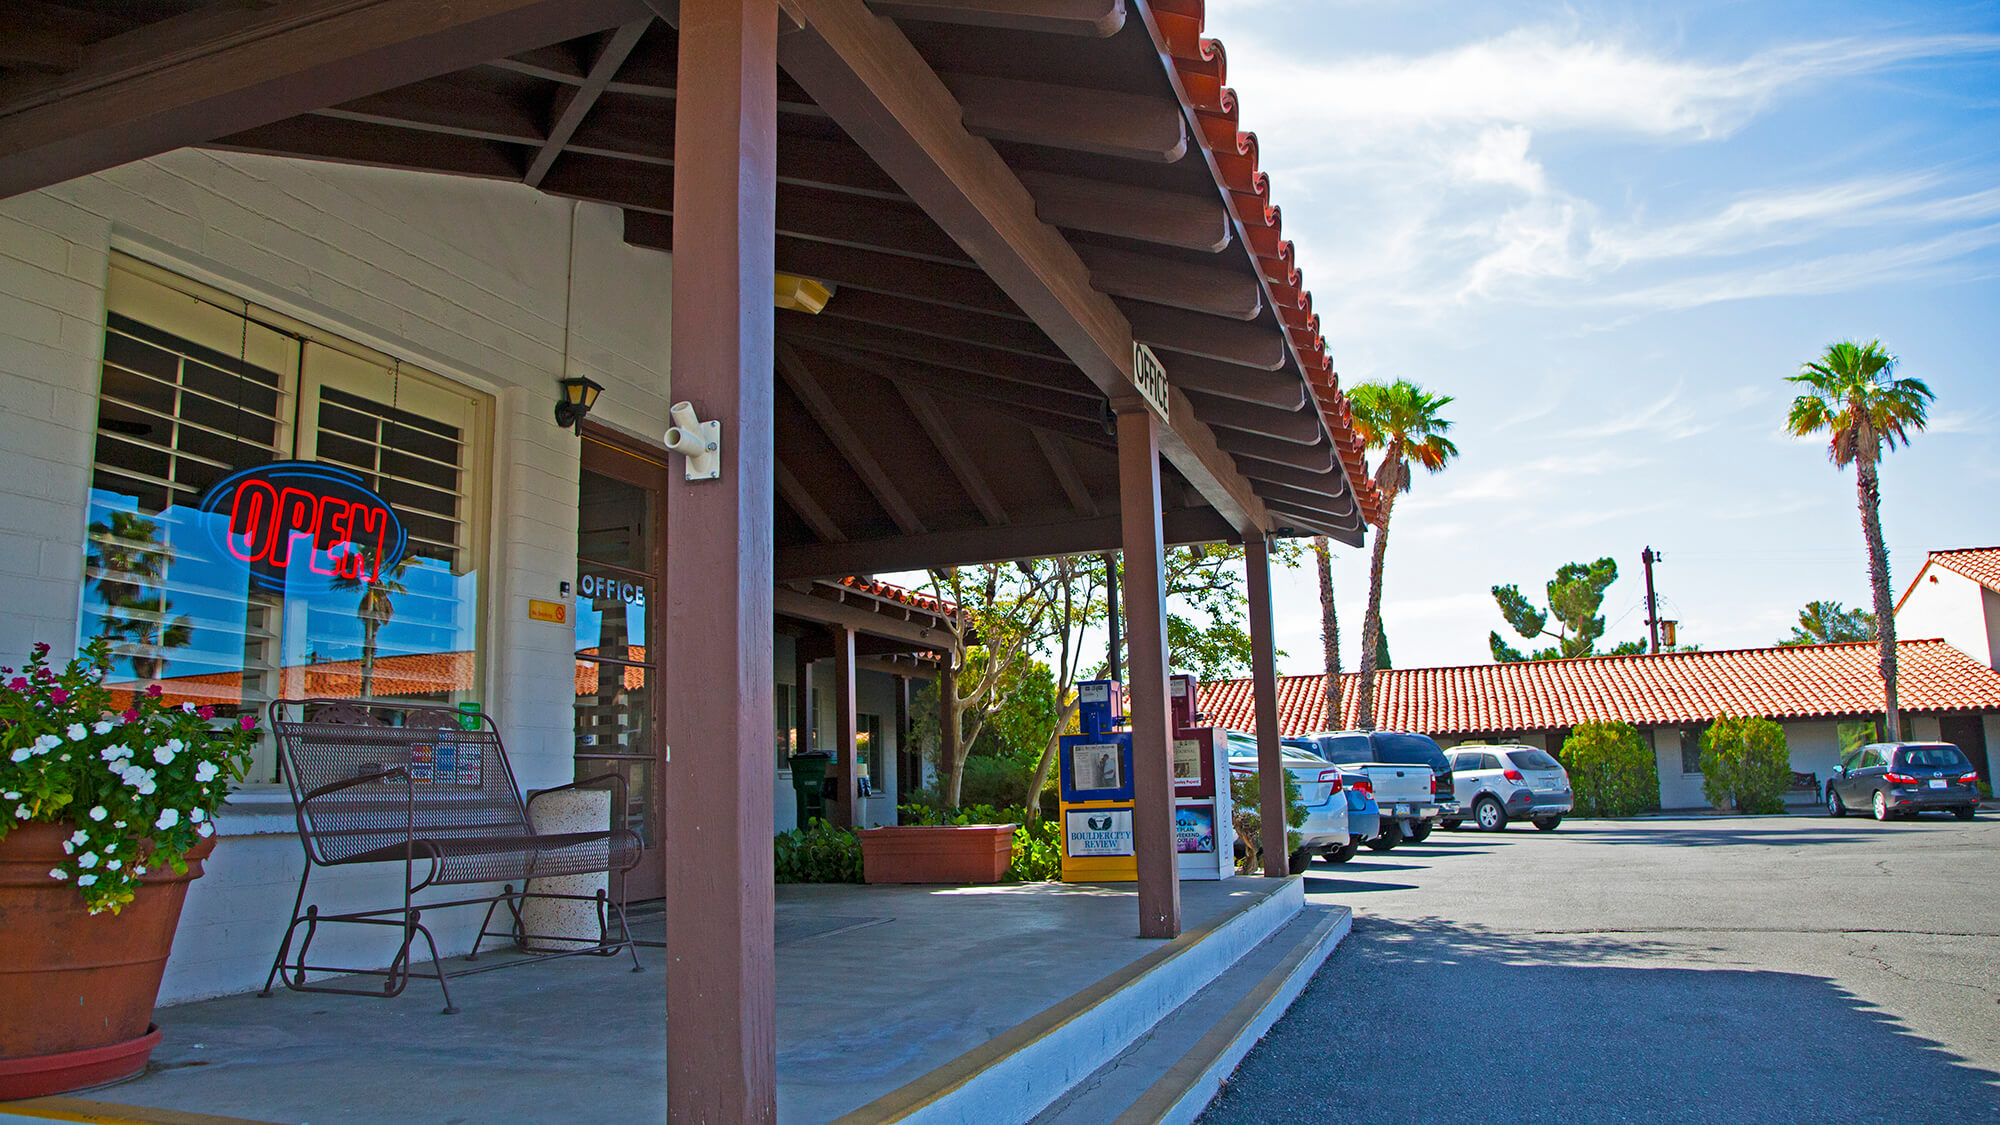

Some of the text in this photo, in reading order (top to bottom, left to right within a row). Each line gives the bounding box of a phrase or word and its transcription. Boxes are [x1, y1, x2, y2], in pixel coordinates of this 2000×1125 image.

[1136, 343, 1168, 415] OFFICE
[227, 479, 387, 583] OPEN
[582, 575, 645, 607] OFFICE
[1071, 831, 1131, 841] BOULDER CITY
[1084, 839, 1117, 849] REVIEW
